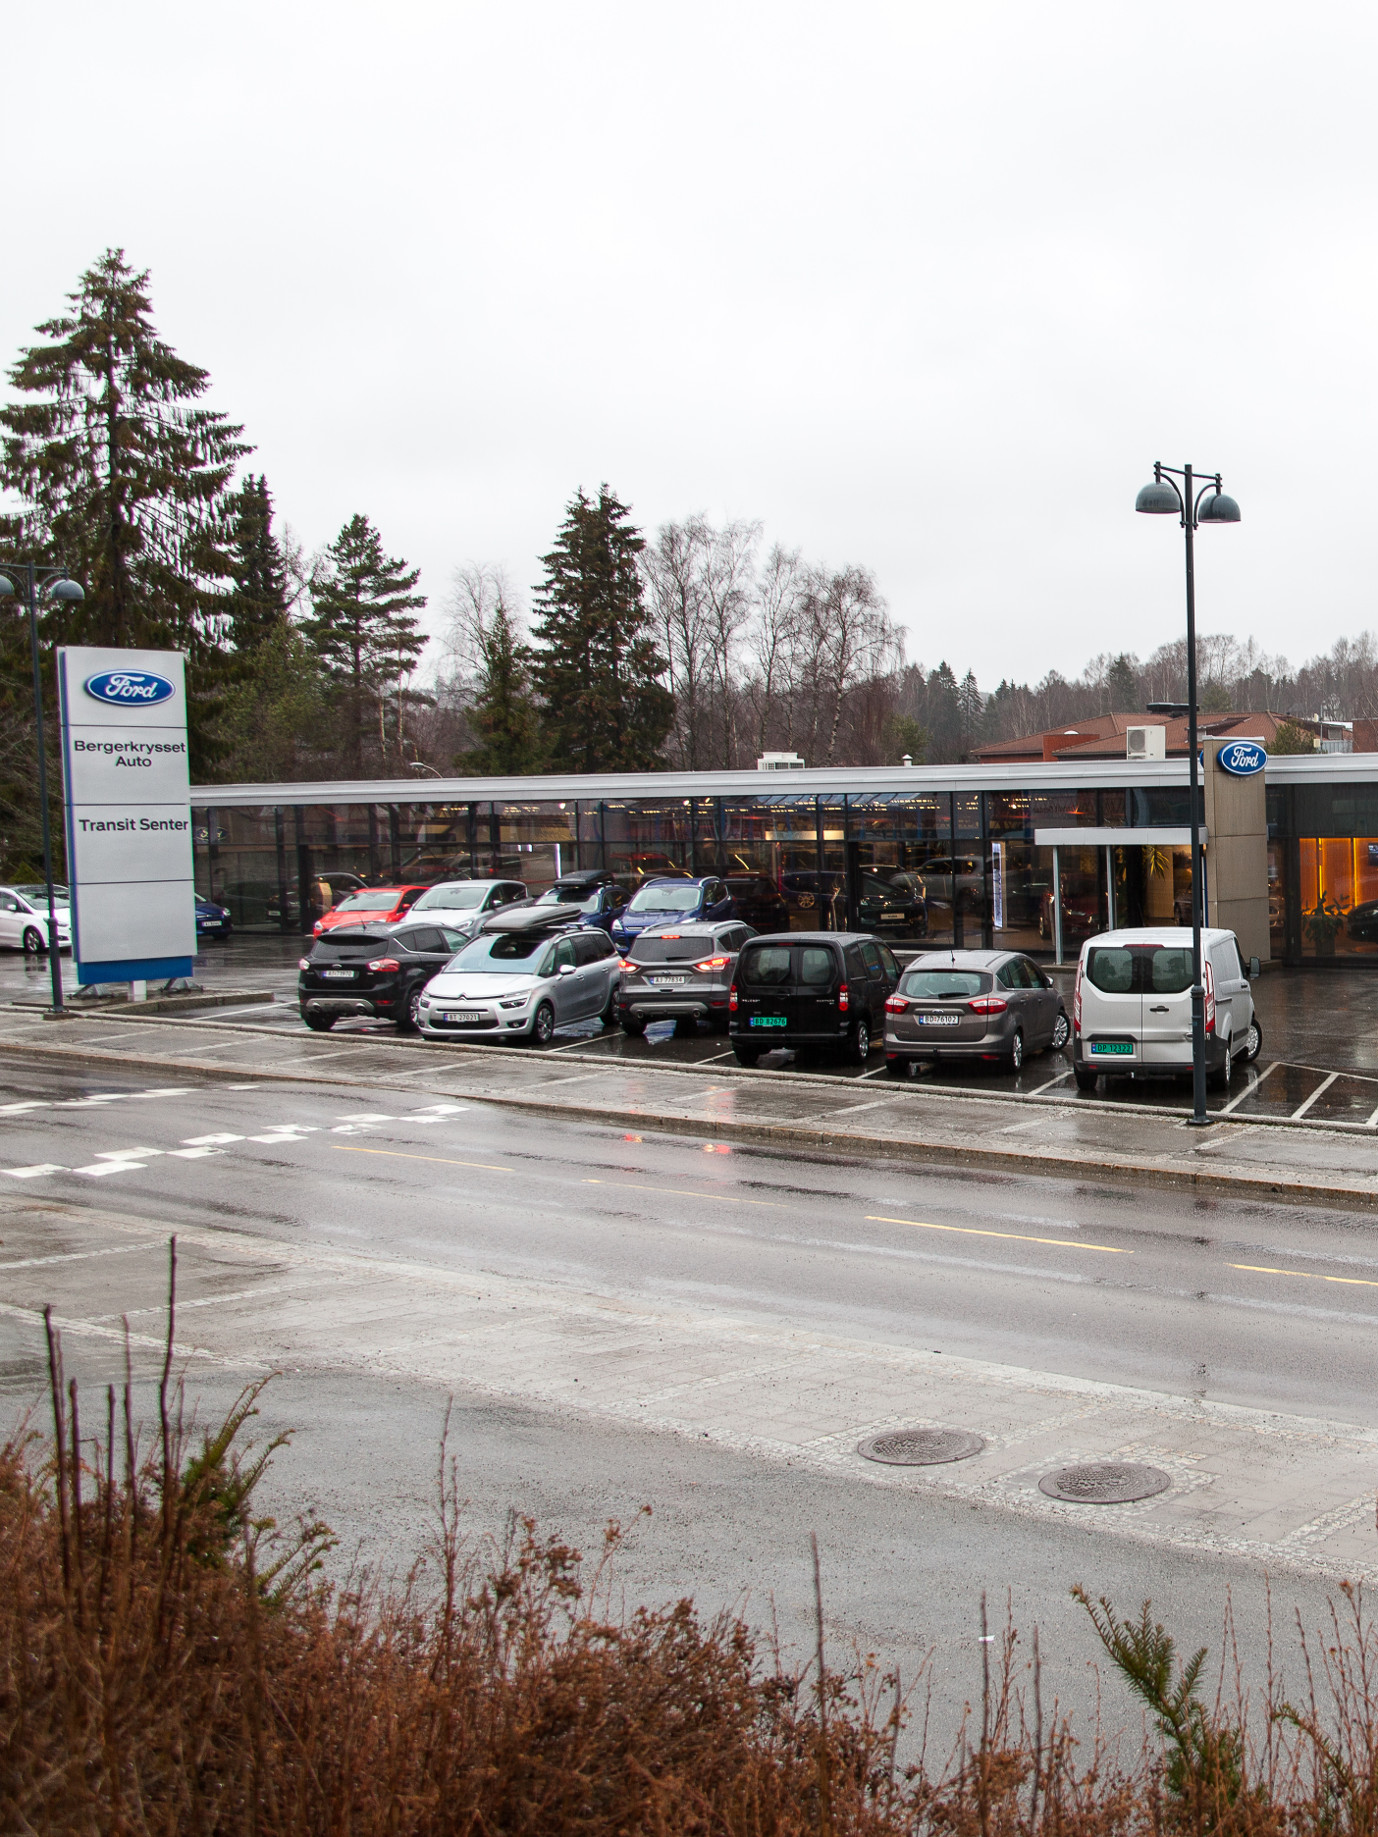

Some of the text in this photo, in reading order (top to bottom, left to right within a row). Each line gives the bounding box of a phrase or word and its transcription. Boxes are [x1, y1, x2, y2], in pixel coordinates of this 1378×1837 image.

[105, 674, 158, 698] Ford
[75, 740, 186, 754] Bergerkrysset
[116, 756, 152, 767] Auto
[1230, 746, 1259, 767] Ford
[79, 818, 189, 832] Transit Senter
